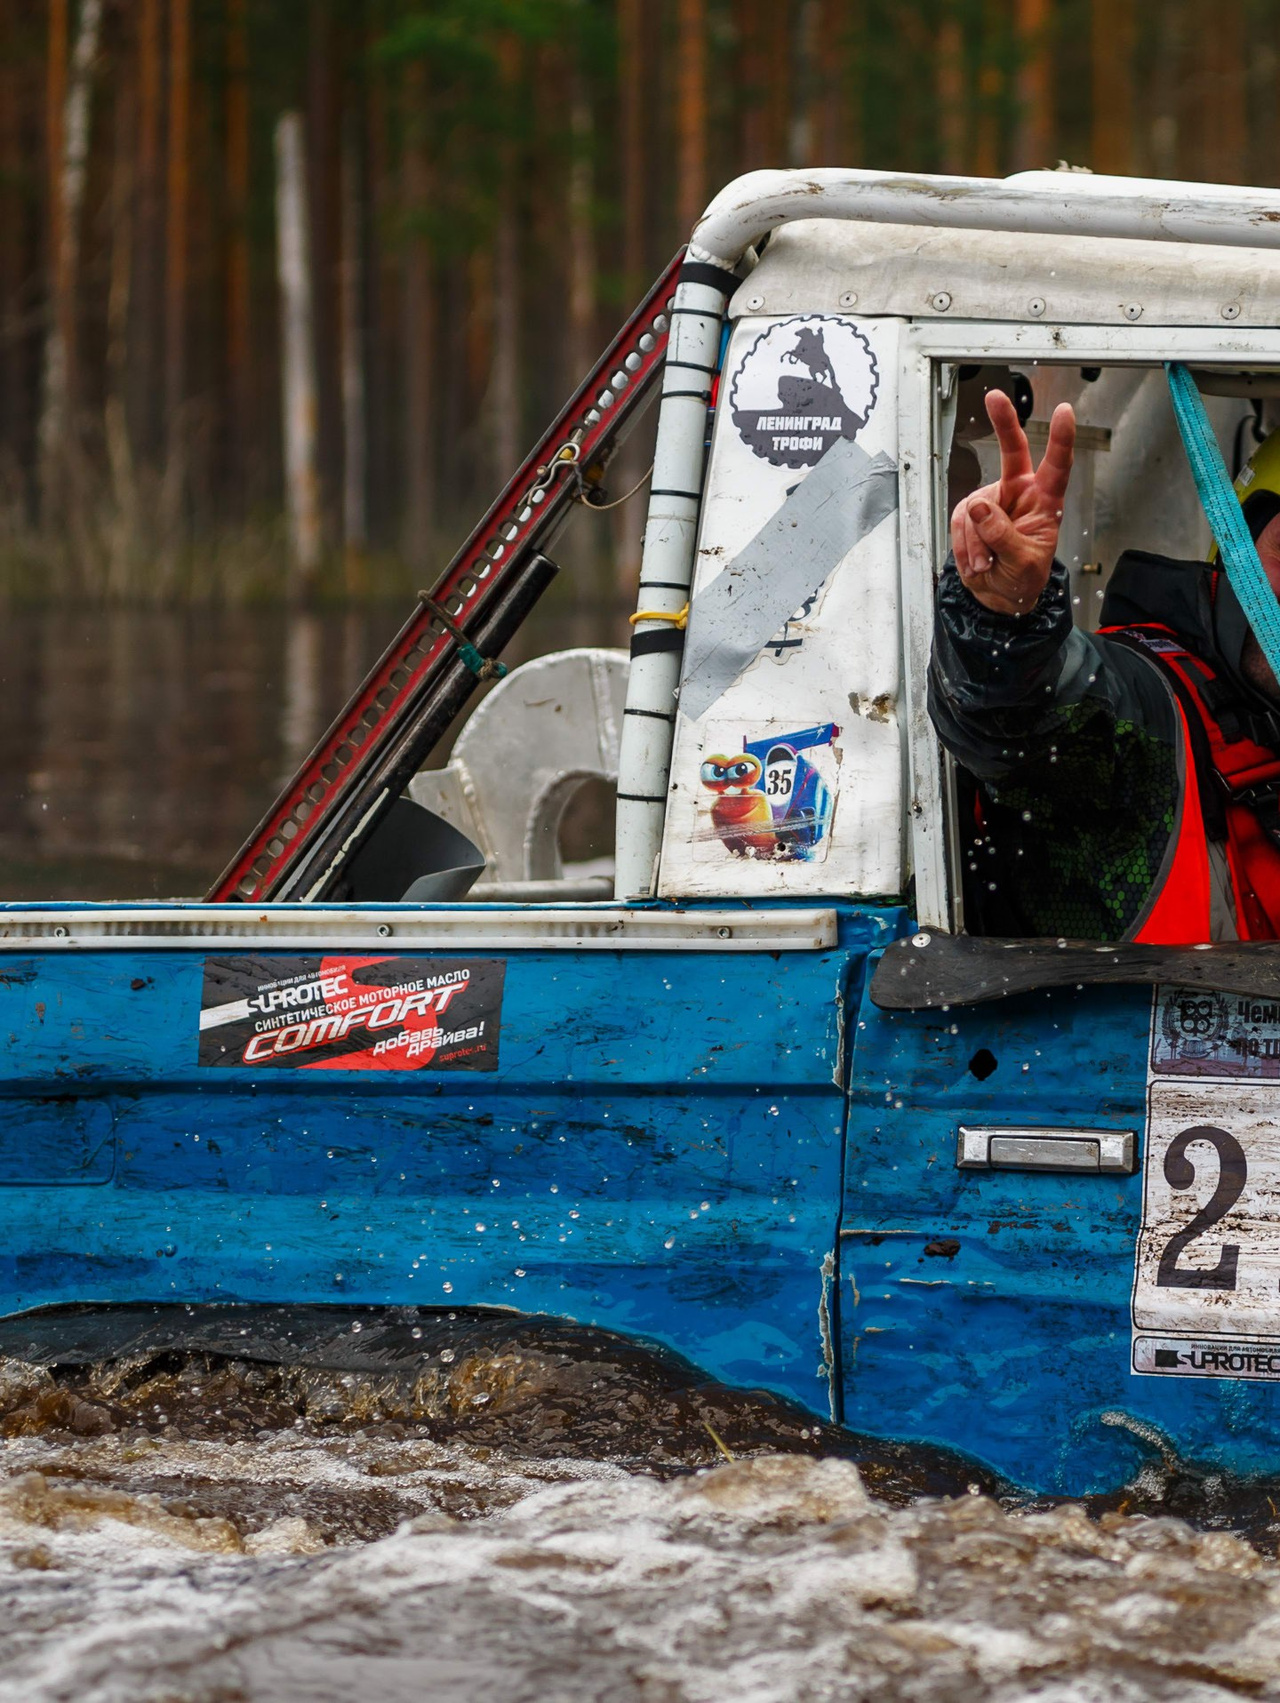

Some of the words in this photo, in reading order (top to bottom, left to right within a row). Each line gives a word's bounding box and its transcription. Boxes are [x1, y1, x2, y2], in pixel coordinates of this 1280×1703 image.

[756, 416, 842, 431] ЛЕНИНГРАД
[772, 436, 823, 452] ТРОФИ
[767, 768, 792, 796] 35
[248, 974, 349, 1013] SUPROTEC
[255, 996, 357, 1033] СИНТЕТИЧЕСКОЕ
[358, 979, 425, 1005] МОТОРНОЕ
[426, 968, 471, 991] МАСЛО
[244, 982, 466, 1062] COMFORT
[373, 1026, 445, 1056] добавь
[406, 1021, 485, 1058] драйва!
